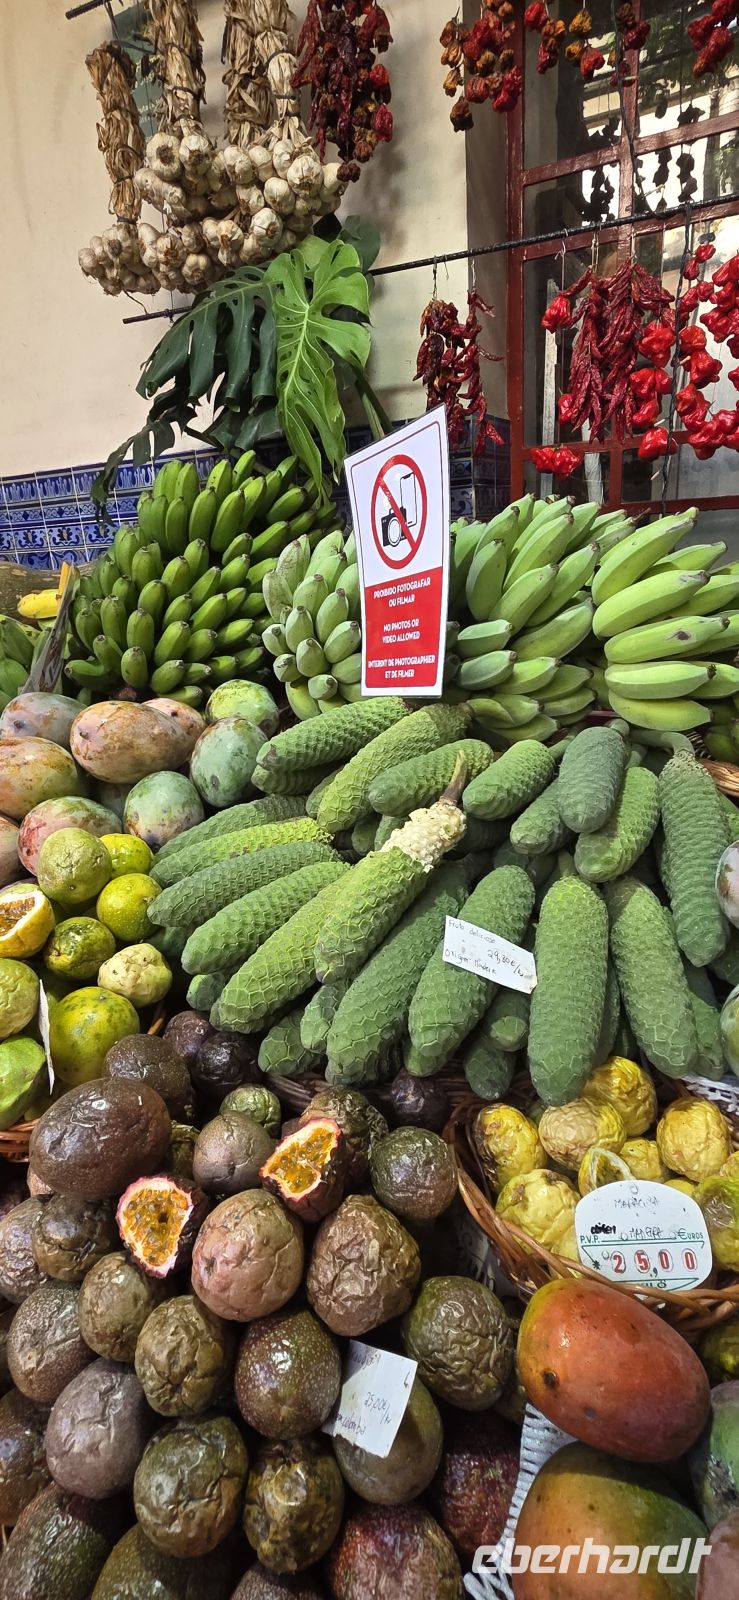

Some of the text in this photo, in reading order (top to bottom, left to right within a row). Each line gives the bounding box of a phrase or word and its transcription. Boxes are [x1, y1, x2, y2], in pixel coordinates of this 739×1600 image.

[374, 577, 431, 599] PROIBIDO FOTOGRAFAR
[389, 594, 415, 607] OU FILMAR
[384, 619, 419, 632] NO PHOTOS OR
[382, 631, 420, 643] VIDEO ALLOWED
[368, 655, 435, 668] INTERDIT DE PHOTOGRAPHIER
[391, 670, 397, 678] DE
[398, 669, 414, 678] FILMER
[580, 1235, 600, 1244] P.V.P.
